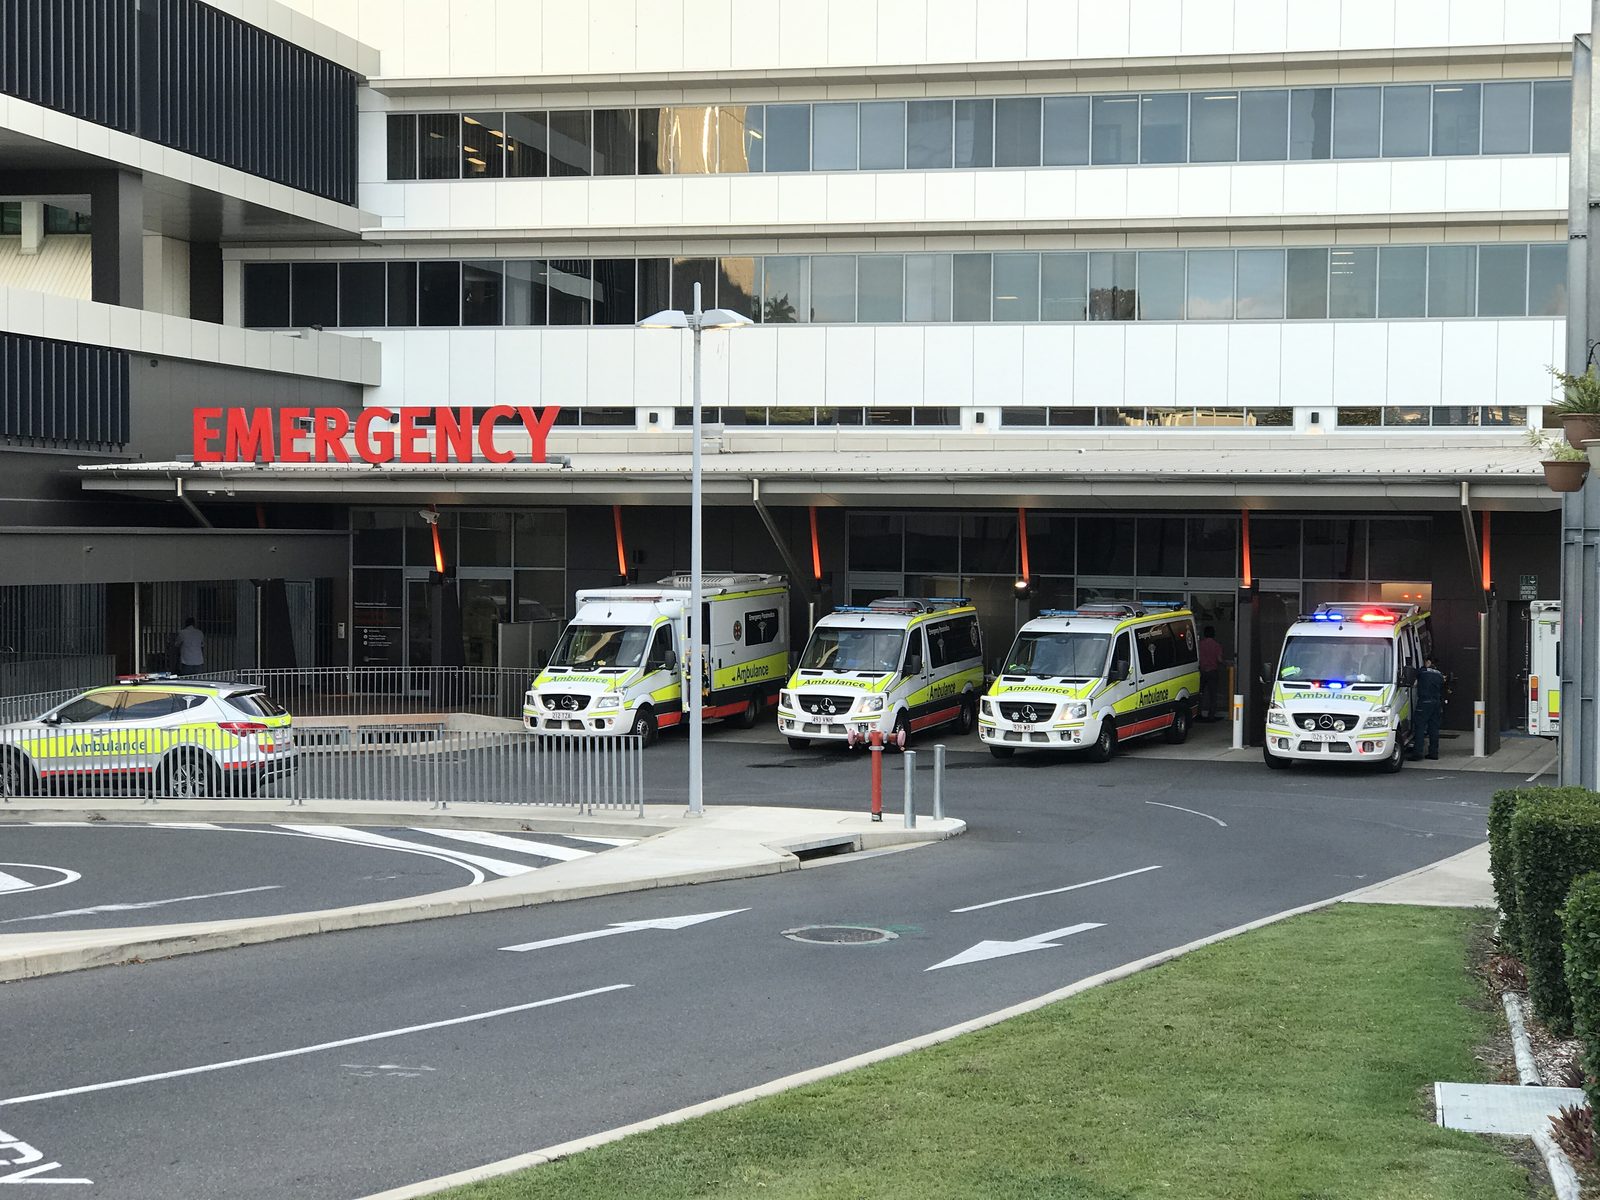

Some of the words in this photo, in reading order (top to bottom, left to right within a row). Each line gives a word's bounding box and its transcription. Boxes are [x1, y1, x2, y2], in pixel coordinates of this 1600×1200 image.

[193, 405, 561, 463] EMERGENCY
[736, 664, 769, 681] Ambulance
[551, 675, 609, 684] Ambulance
[803, 679, 866, 688] Ambulance
[930, 681, 956, 700] Ambulance
[1005, 685, 1070, 695] Ambulance
[1139, 688, 1169, 706] Ambulance
[1293, 692, 1367, 702] Ambulance
